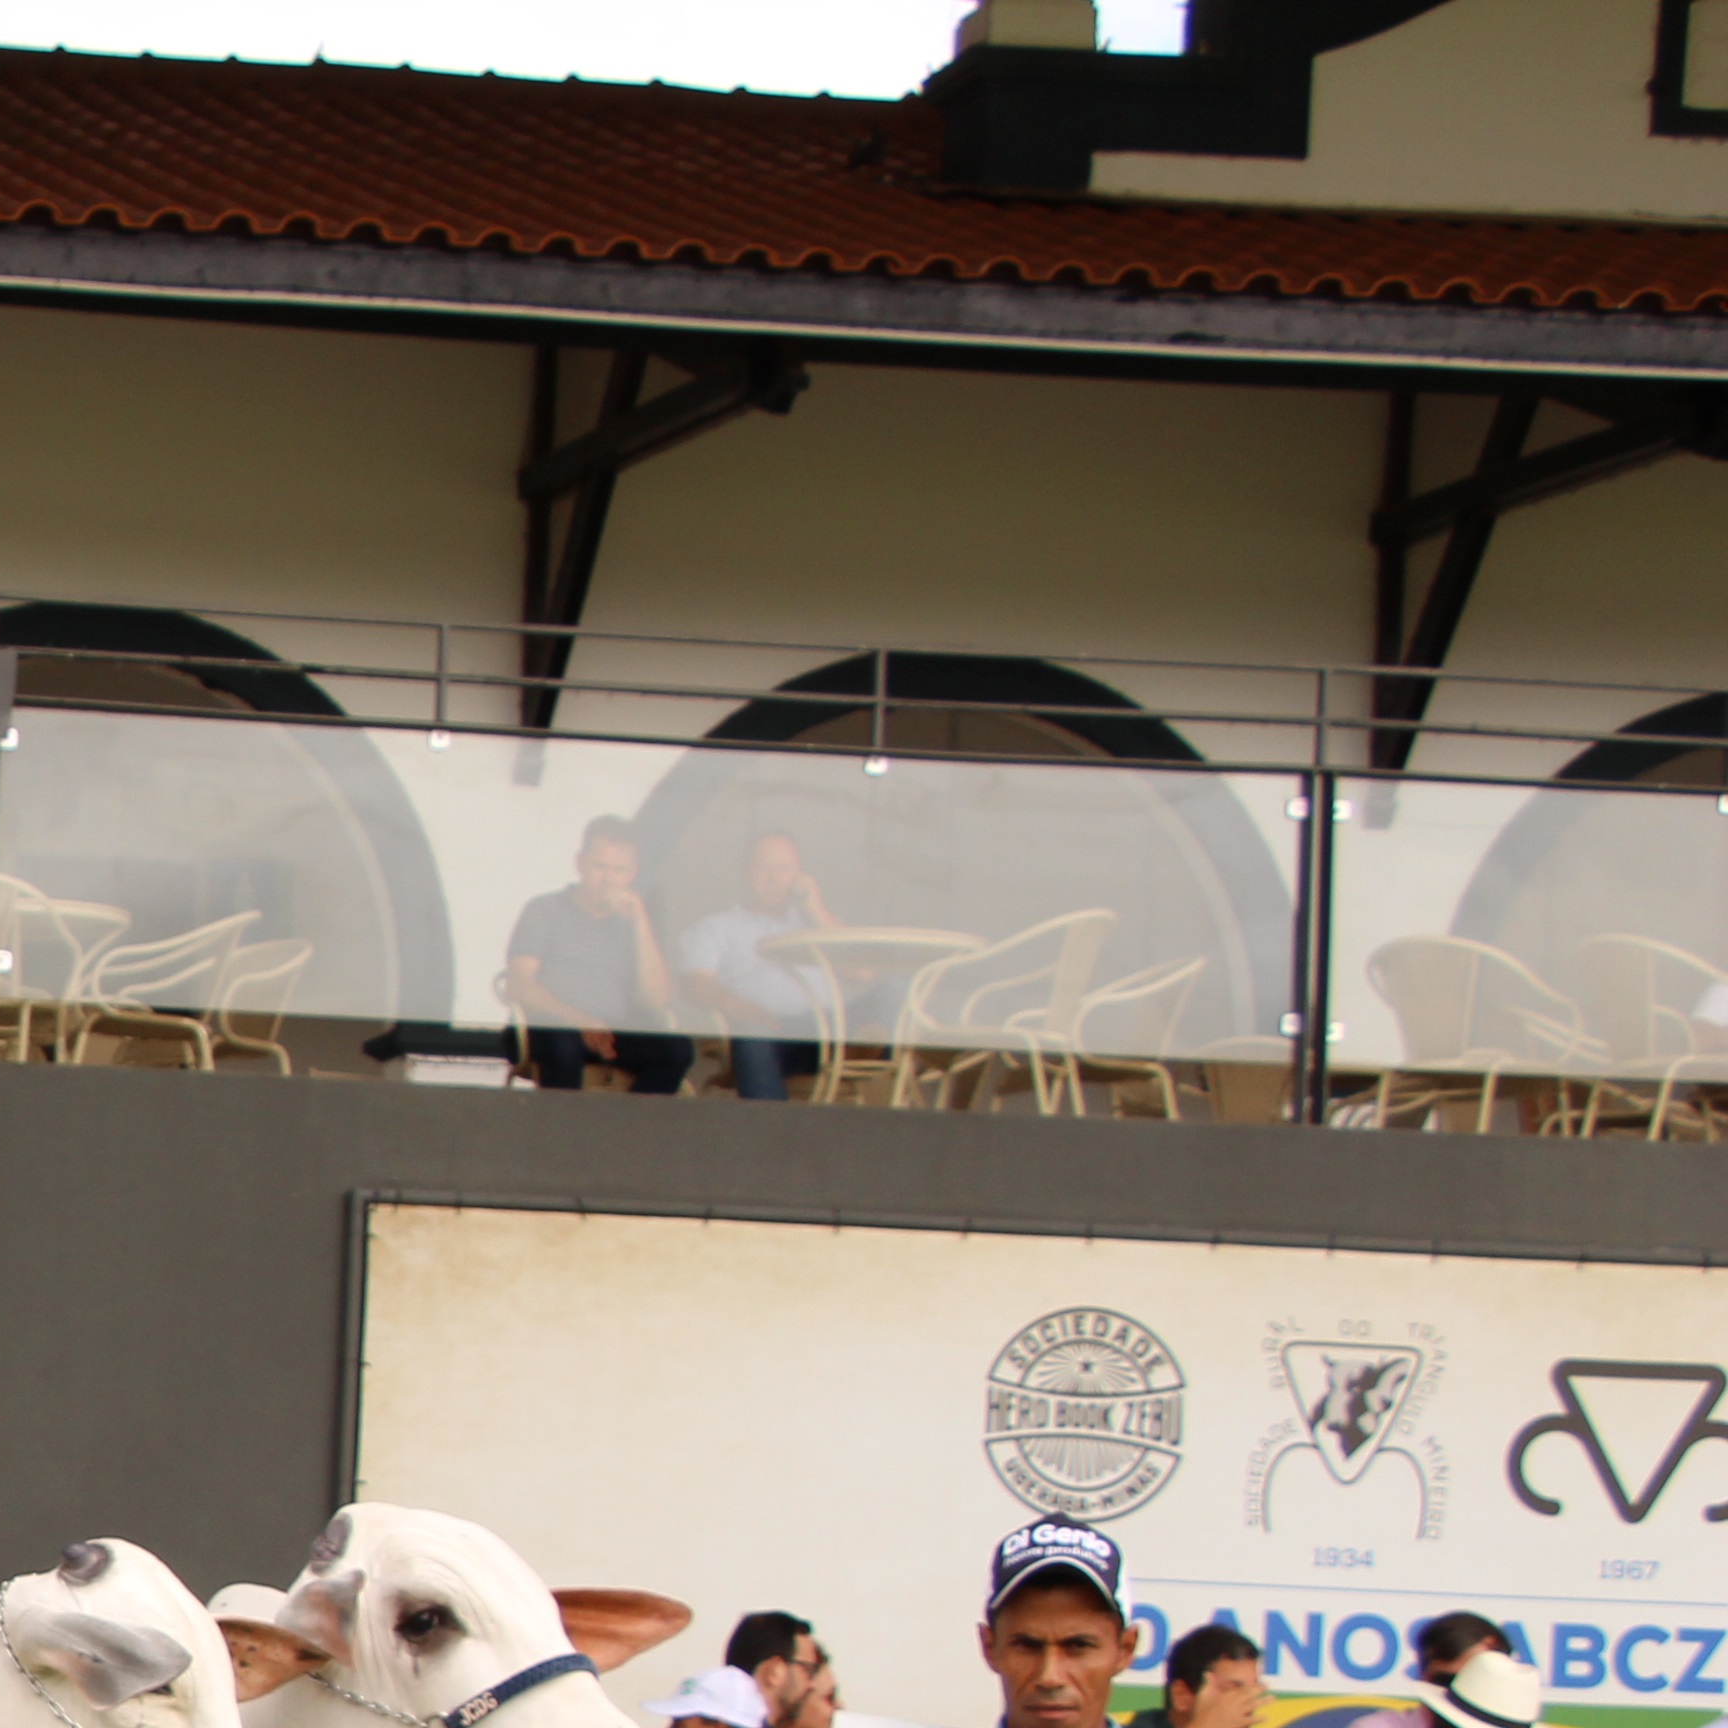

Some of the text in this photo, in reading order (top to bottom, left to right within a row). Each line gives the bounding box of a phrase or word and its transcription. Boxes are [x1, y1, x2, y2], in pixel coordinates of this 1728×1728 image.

[1006, 1313, 1166, 1370] SOCIEDADE
[1055, 1399, 1115, 1432] BOOK
[1312, 1547, 1375, 1568] 1934
[1599, 1558, 1661, 1581] 1967
[1208, 1606, 1444, 1682] NO
